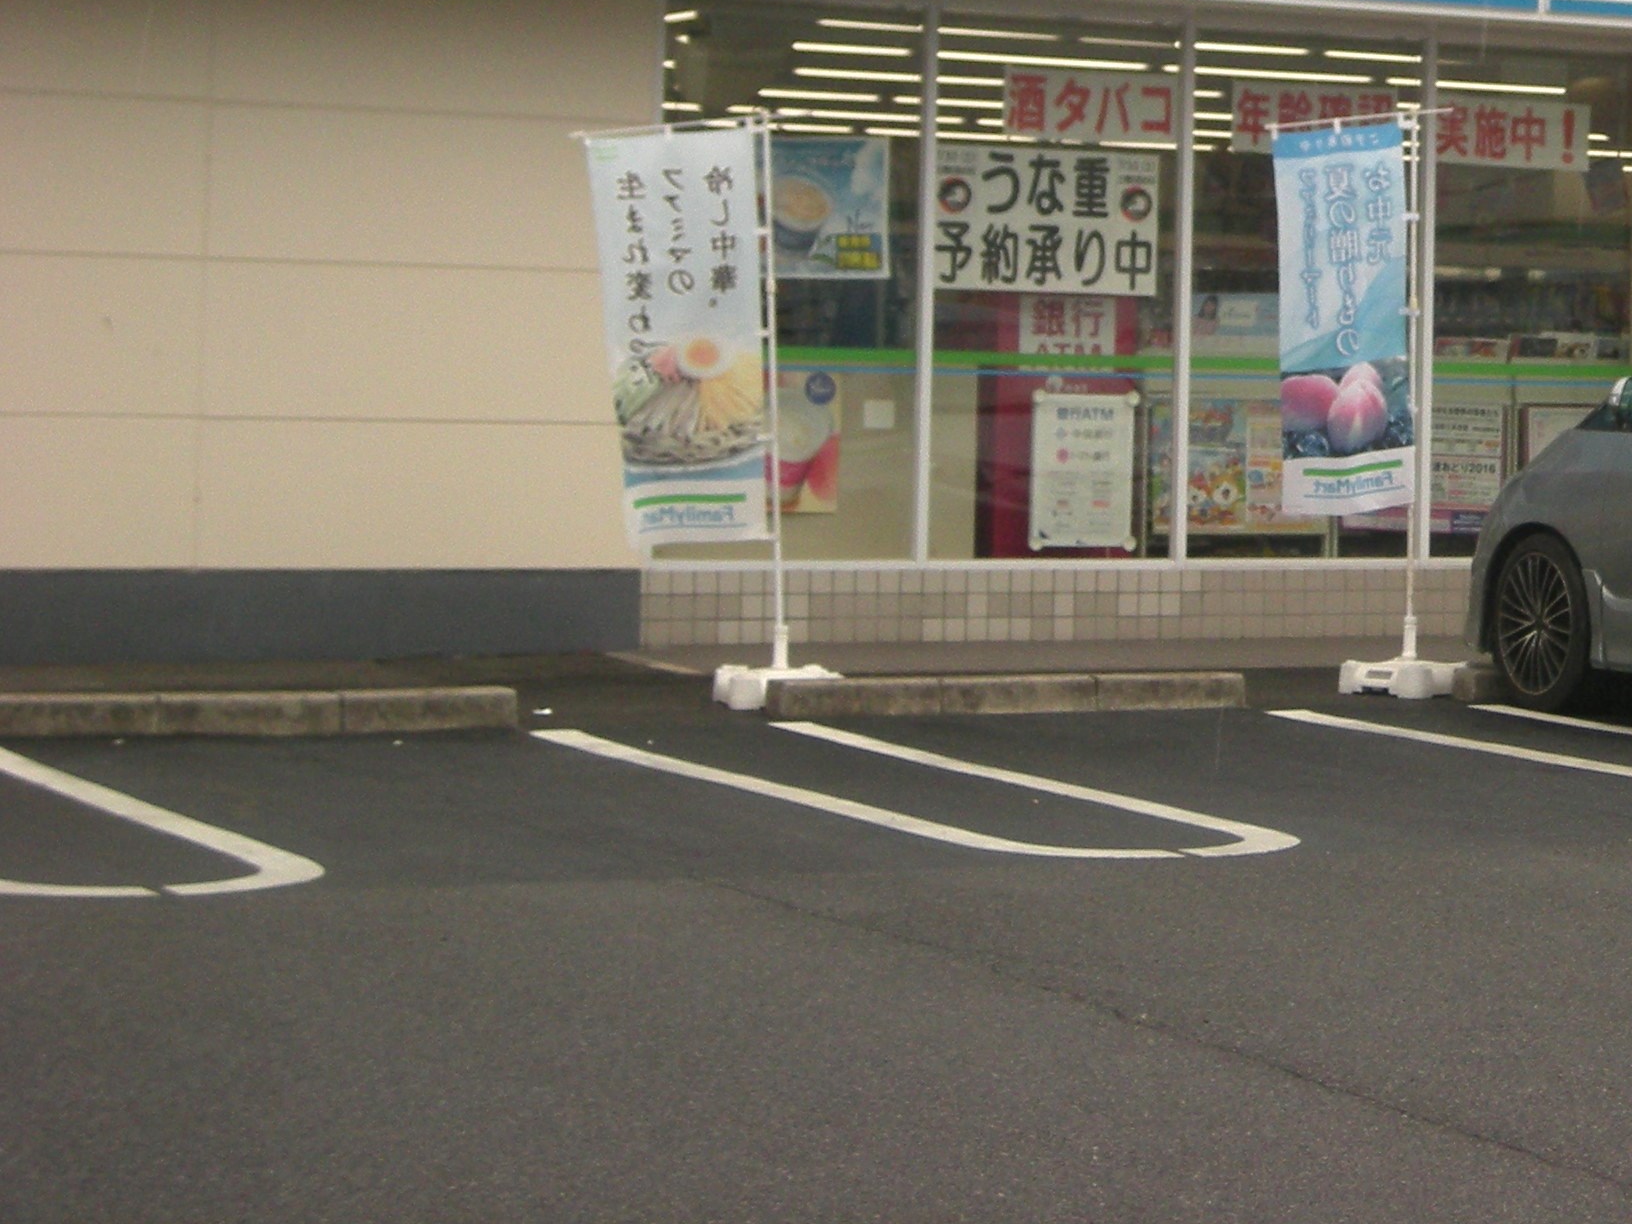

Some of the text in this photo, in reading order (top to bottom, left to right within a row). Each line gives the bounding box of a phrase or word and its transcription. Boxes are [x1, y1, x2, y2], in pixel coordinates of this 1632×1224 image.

[1008, 74, 1172, 133] 酒タバコ
[981, 151, 1110, 218] うな重
[935, 221, 1152, 291] 予約承り中
